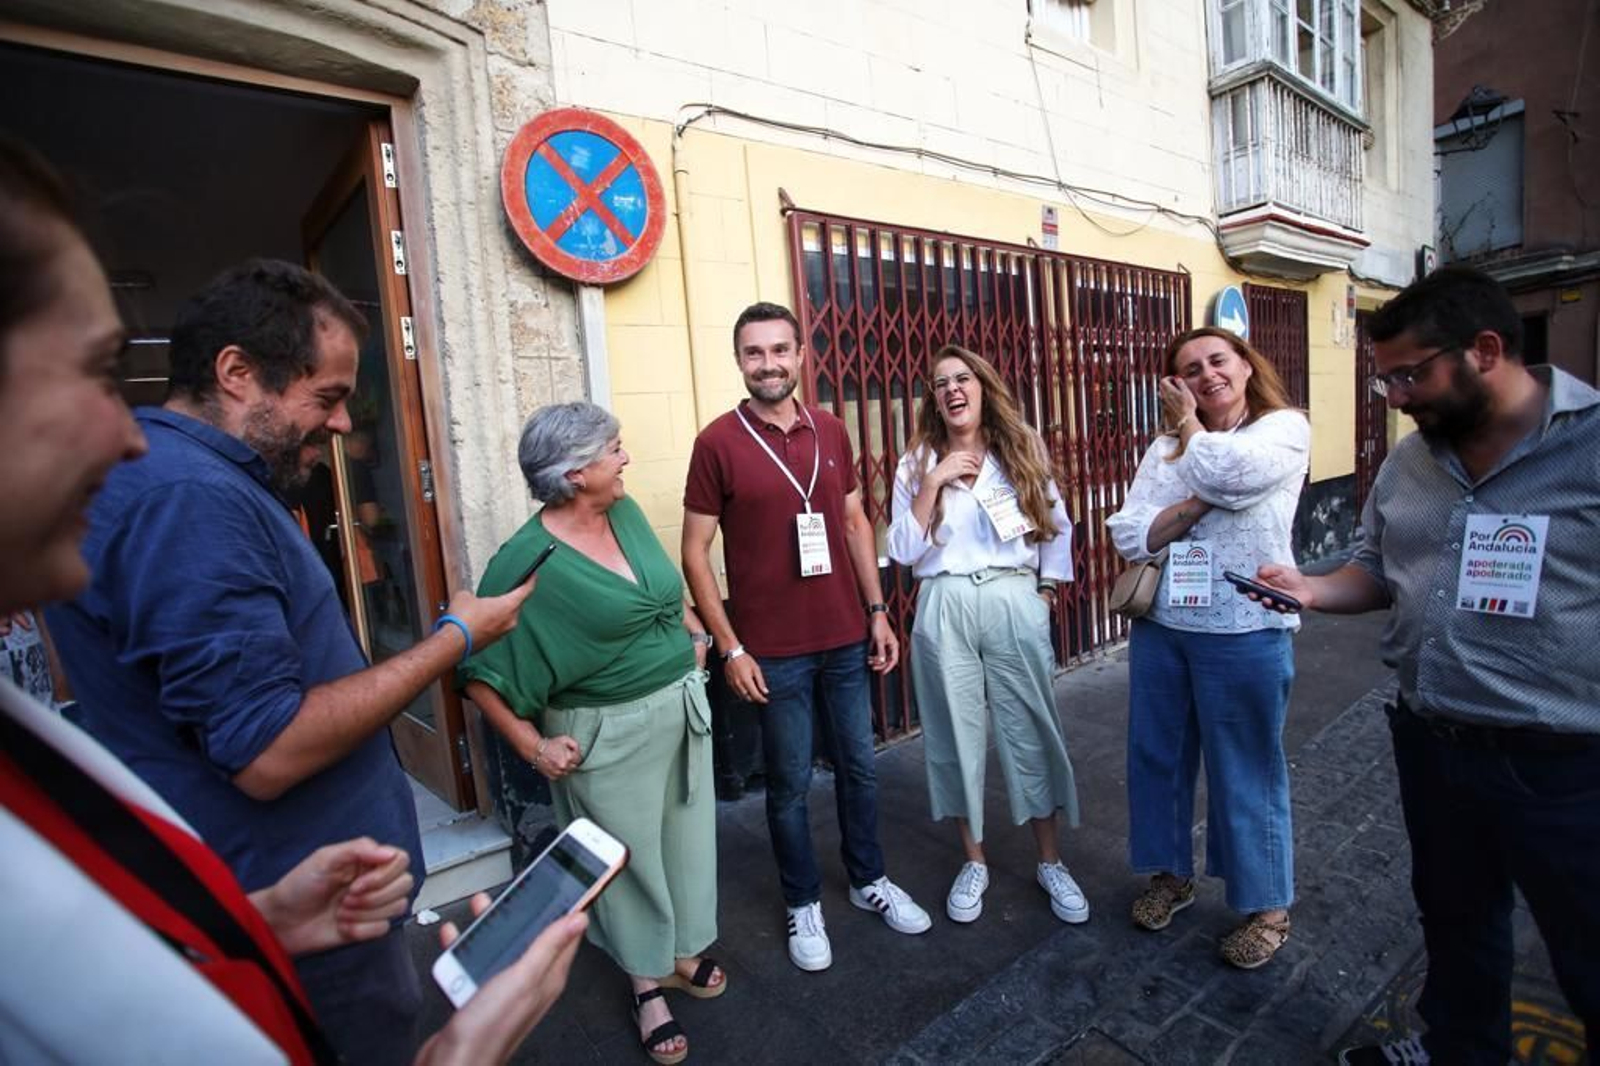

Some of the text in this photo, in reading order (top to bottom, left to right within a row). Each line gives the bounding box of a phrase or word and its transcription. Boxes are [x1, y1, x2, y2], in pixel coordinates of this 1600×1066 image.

[1469, 531, 1491, 541] Por
[1467, 559, 1532, 571] apoderada
[1466, 569, 1532, 581] apoderado
